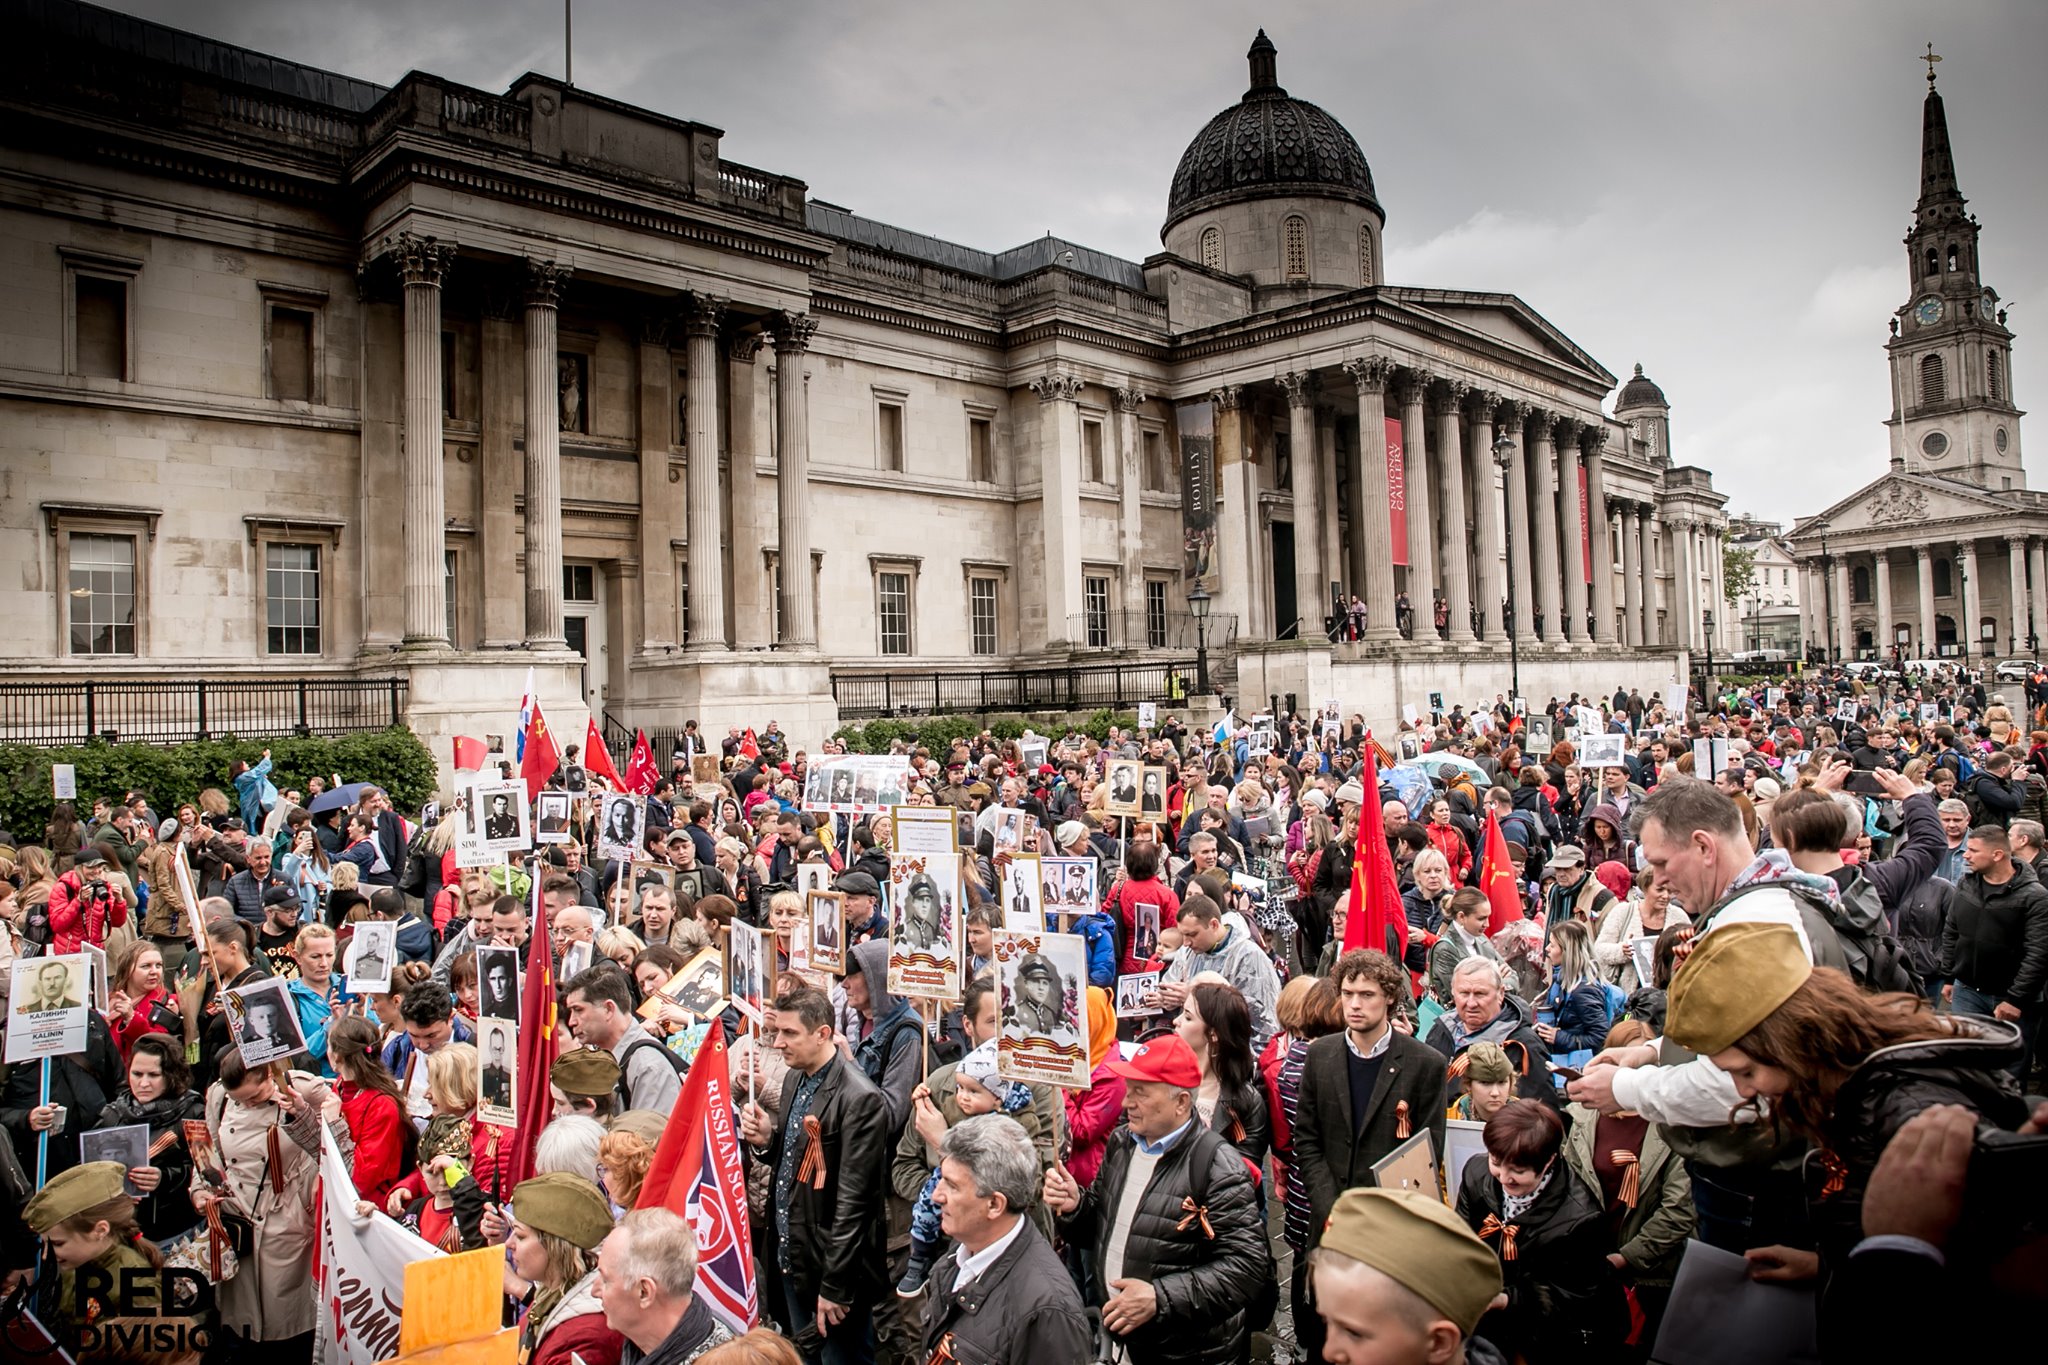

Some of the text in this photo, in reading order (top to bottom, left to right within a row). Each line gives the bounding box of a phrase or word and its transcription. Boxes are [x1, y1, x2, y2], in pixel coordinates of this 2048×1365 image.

[1190, 450, 1202, 511] BOILLY
[1388, 445, 1397, 509] NATIONAL
[1393, 442, 1404, 511] GALLERY
[29, 1009, 68, 1020] КАЛИНИН
[32, 1030, 64, 1040] KALININ
[707, 1078, 738, 1168] RUSSIAN
